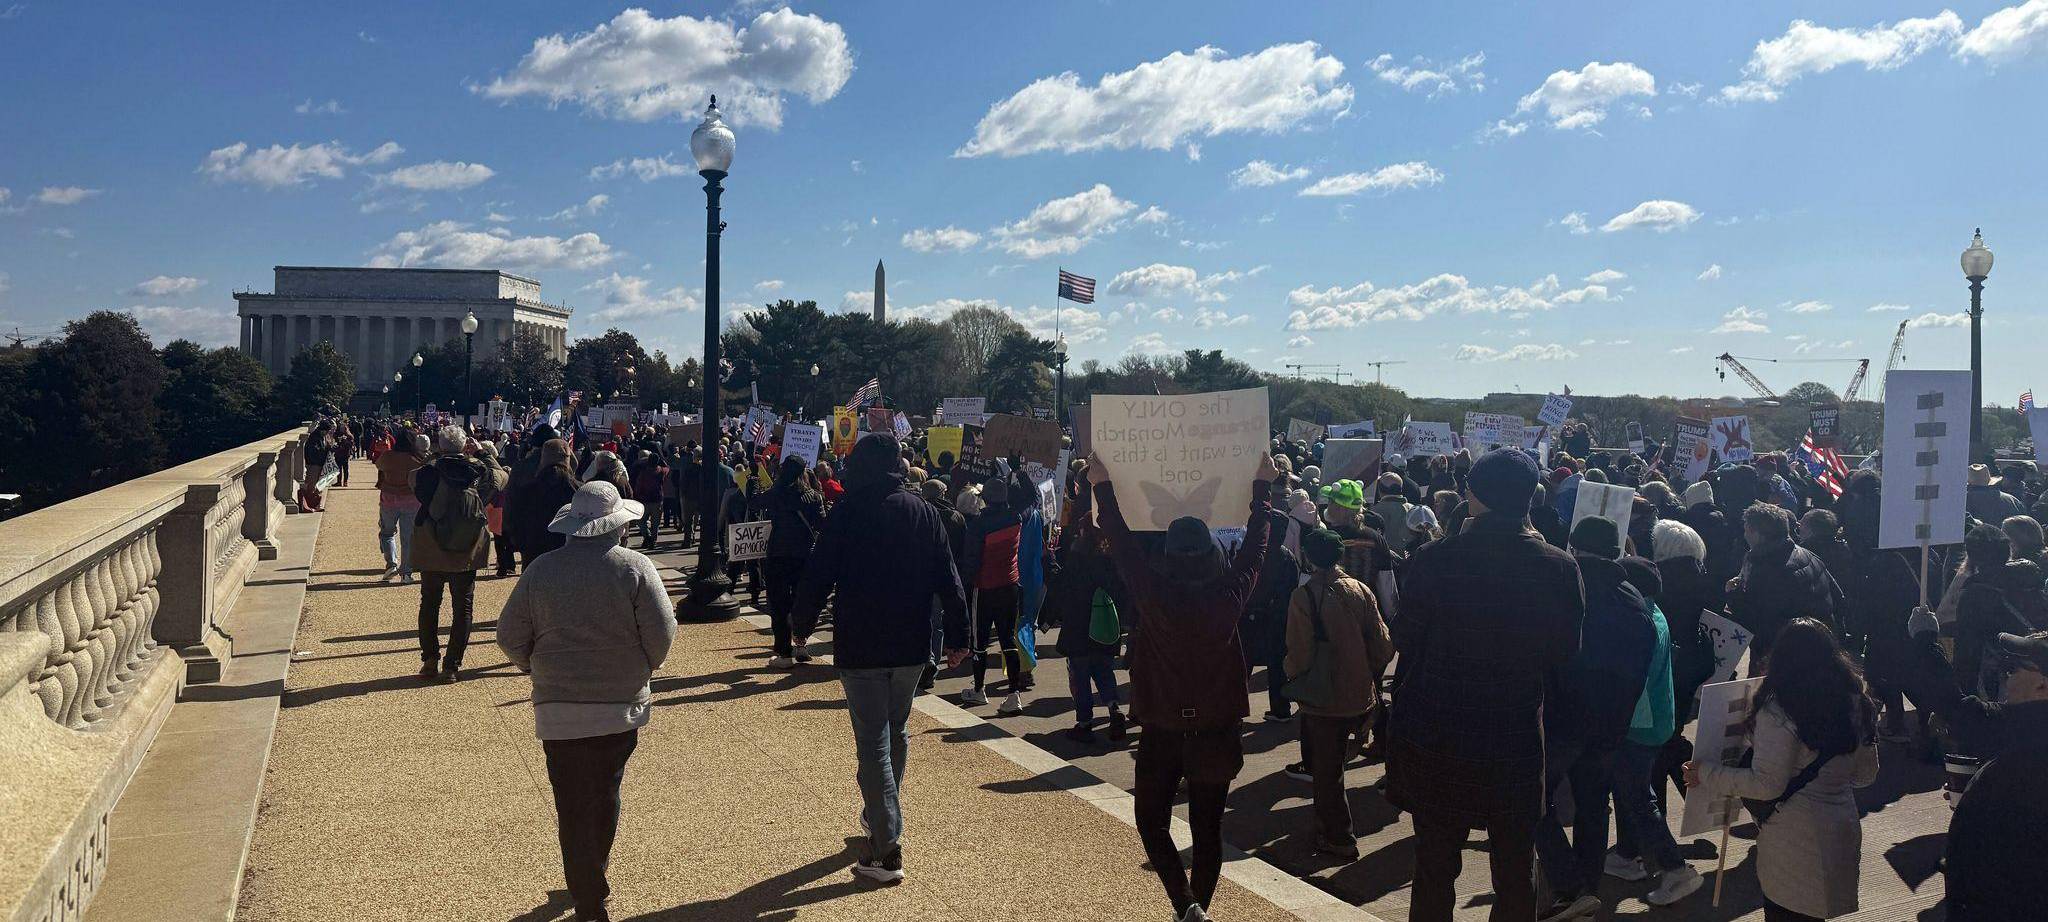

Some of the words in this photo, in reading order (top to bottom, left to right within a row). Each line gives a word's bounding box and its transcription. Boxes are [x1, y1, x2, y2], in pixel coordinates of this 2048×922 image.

[1549, 395, 1570, 409] STOP
[1545, 405, 1562, 418] KING
[1811, 410, 1838, 419] TRUMP
[1813, 418, 1836, 428] MUST
[1677, 423, 1707, 436] TRUMP
[1818, 427, 1830, 435] GO
[962, 446, 973, 454] NO
[973, 457, 992, 467] ICE
[735, 526, 764, 541] SAVE
